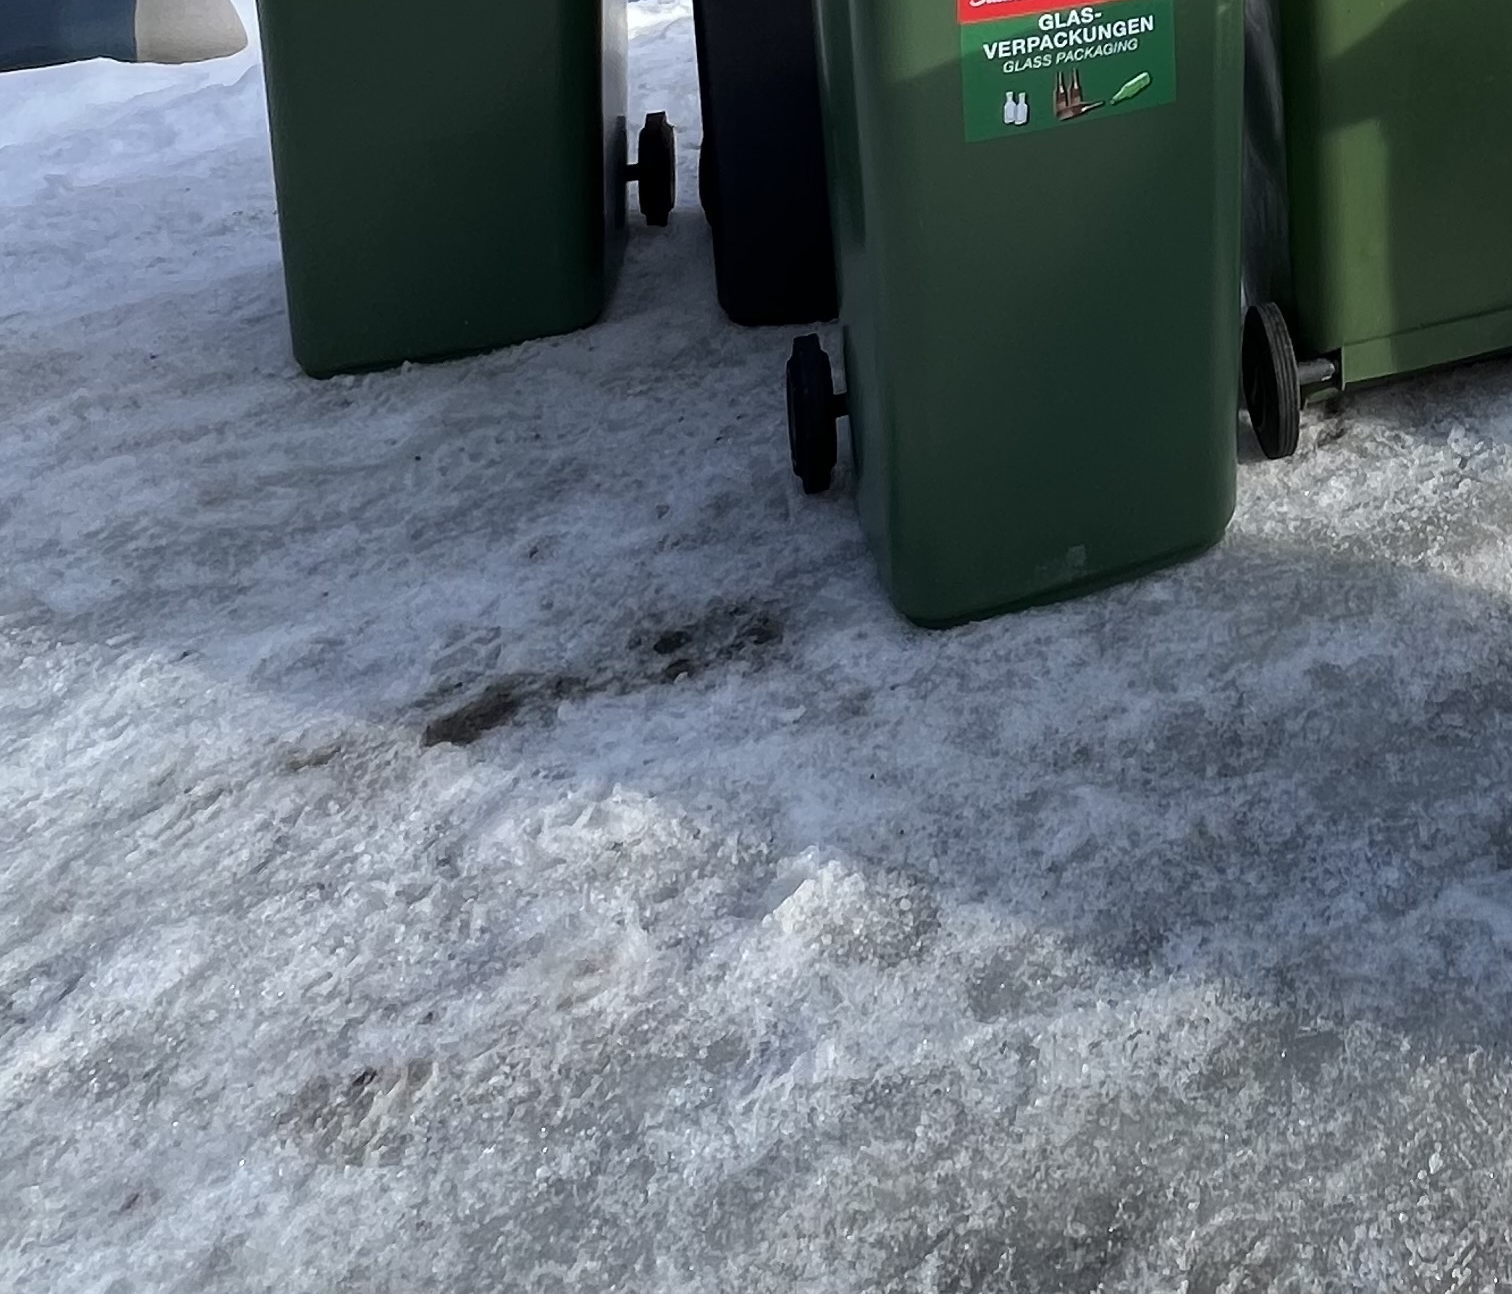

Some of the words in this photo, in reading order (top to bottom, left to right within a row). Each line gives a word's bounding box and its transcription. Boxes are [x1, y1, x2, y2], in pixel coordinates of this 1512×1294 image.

[1038, 7, 1102, 31] GLAS-
[983, 15, 1154, 60] VERPACKUNGEN
[1003, 55, 1052, 73] GLASS
[1055, 38, 1138, 64] PACKAGING
